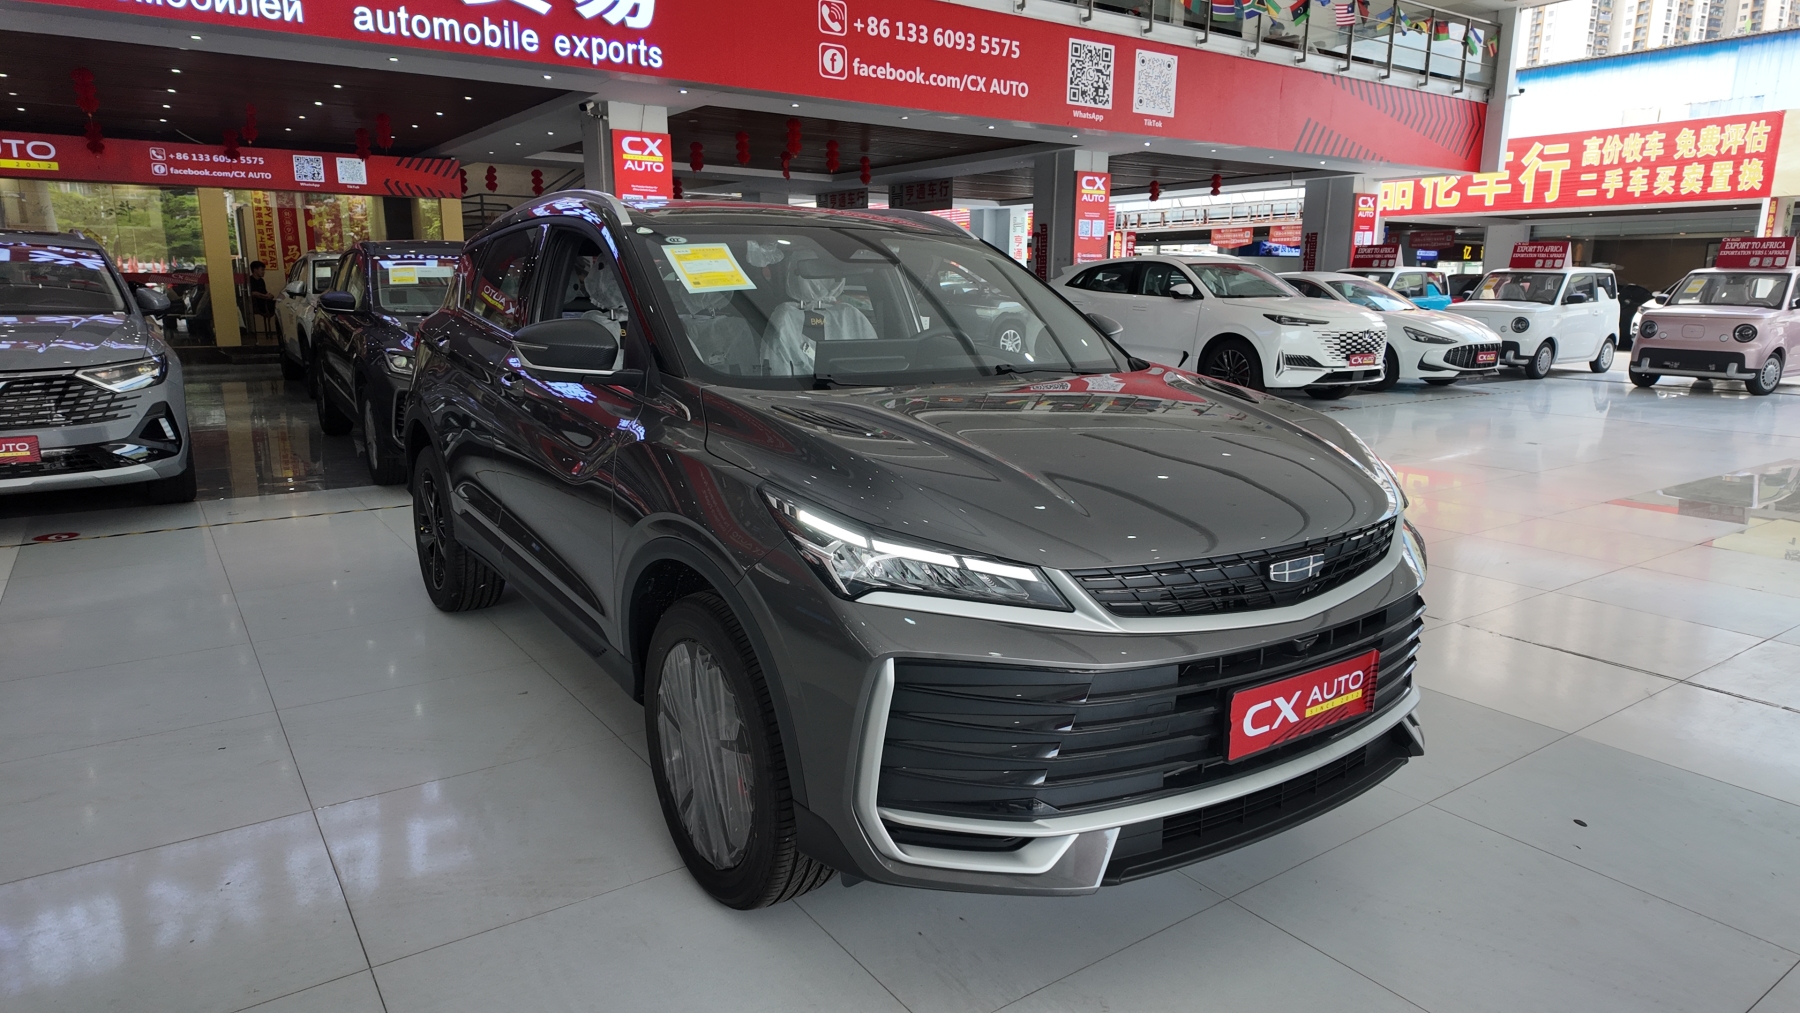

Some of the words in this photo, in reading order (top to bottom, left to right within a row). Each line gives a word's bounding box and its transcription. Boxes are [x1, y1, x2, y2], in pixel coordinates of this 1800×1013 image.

[353, 6, 540, 51] automobile
[554, 34, 663, 67] exports
[853, 16, 890, 38] +86
[895, 21, 928, 44] 133
[933, 28, 976, 51] 6093
[981, 36, 1020, 58] 5575
[853, 58, 986, 92] facebook.com/CX
[989, 79, 1029, 98] AUTO
[1072, 110, 1104, 122] WhatsApp
[1144, 119, 1162, 127] TikTok
[0, 139, 56, 159] TO
[621, 136, 663, 157] CX
[1581, 130, 1666, 166] 高价收车
[1673, 120, 1771, 159] 免费评估
[191, 153, 210, 161] 133
[240, 156, 265, 165] 5575
[624, 160, 664, 173] AUTO
[170, 167, 246, 179] facebook.com/CX
[1577, 157, 1763, 198] 二手车买卖置换
[905, 181, 950, 200] 亨通车行
[1081, 176, 1106, 190] CX
[262, 191, 272, 218] APPY
[1081, 194, 1105, 202] AUTO
[1358, 197, 1375, 207] CX
[1725, 241, 1751, 249] EXPORT
[1761, 241, 1785, 249] AFRICA
[1351, 356, 1363, 364] CX
[1243, 690, 1302, 737] CX
[1306, 670, 1364, 707] AUTO
[1309, 701, 1336, 715] SINCE
[1340, 692, 1360, 703] 2012
